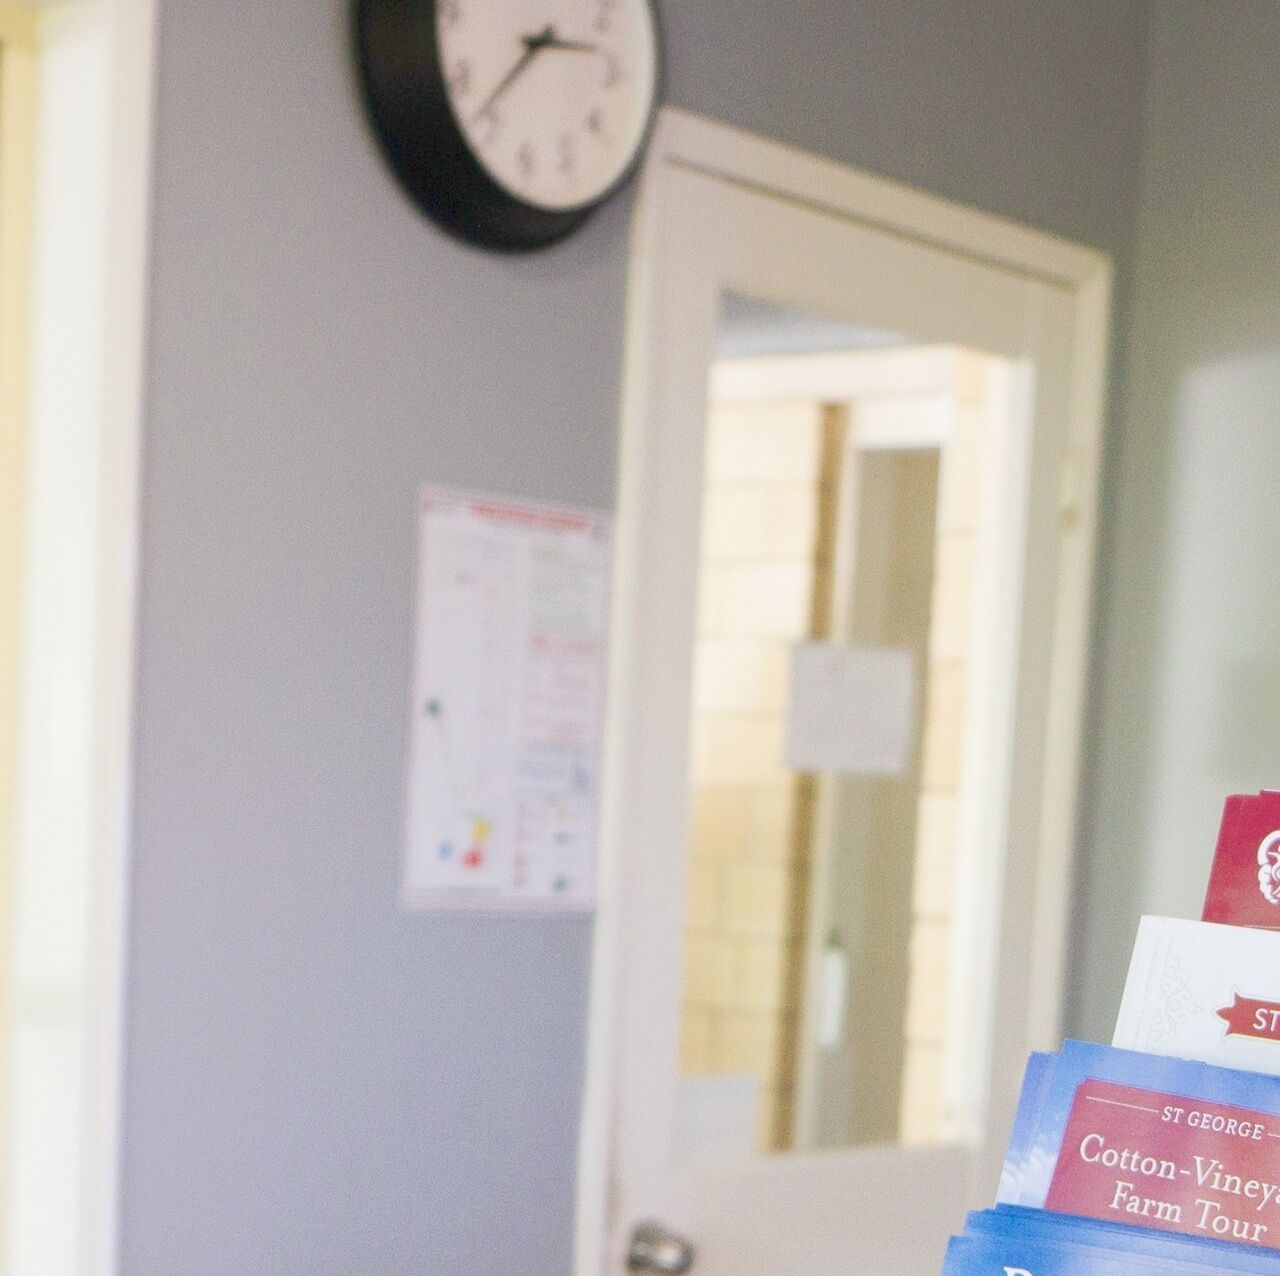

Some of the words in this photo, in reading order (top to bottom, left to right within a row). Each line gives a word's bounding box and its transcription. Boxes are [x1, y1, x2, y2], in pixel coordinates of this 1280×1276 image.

[1161, 1106, 1184, 1124] ST
[1187, 1111, 1264, 1140] GEORGE
[1109, 1180, 1182, 1223] Farm
[1194, 1198, 1268, 1242] Tour
